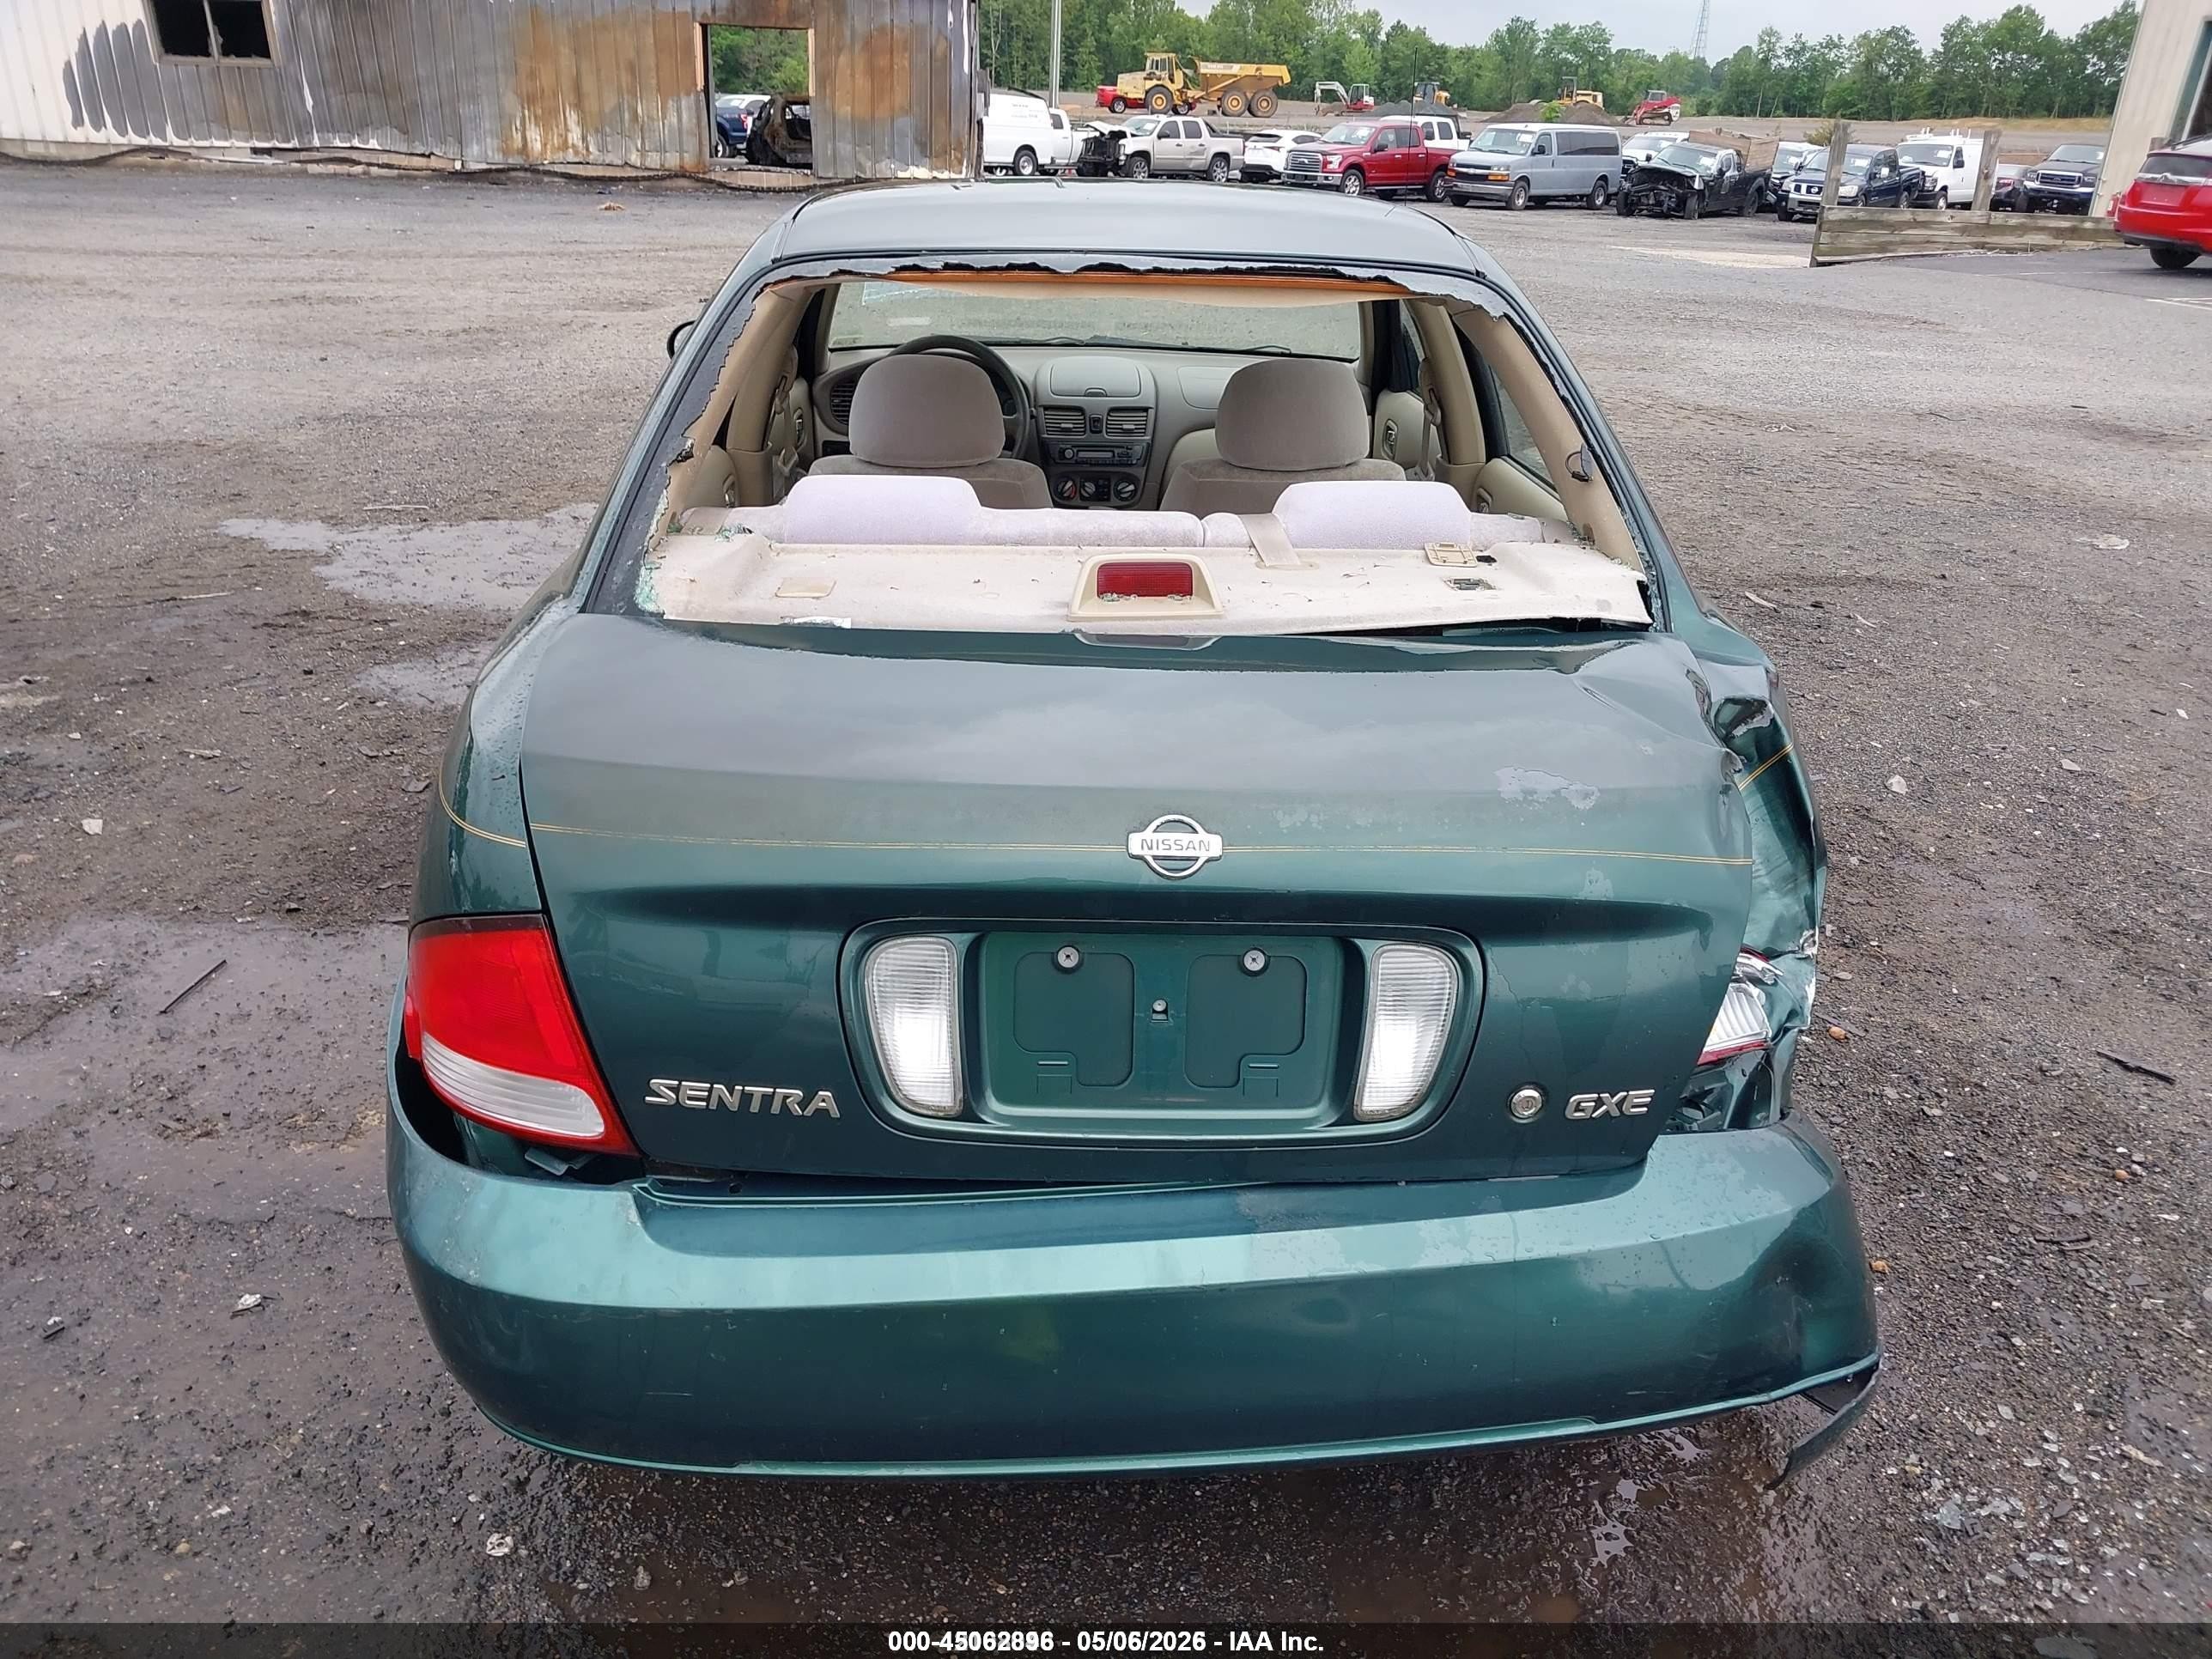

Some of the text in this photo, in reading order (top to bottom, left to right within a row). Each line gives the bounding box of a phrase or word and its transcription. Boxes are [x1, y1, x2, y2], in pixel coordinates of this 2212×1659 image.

[1140, 838, 1211, 852] NISSAN
[645, 1079, 841, 1119] SENTRA
[1565, 1089, 1656, 1120] GXE
